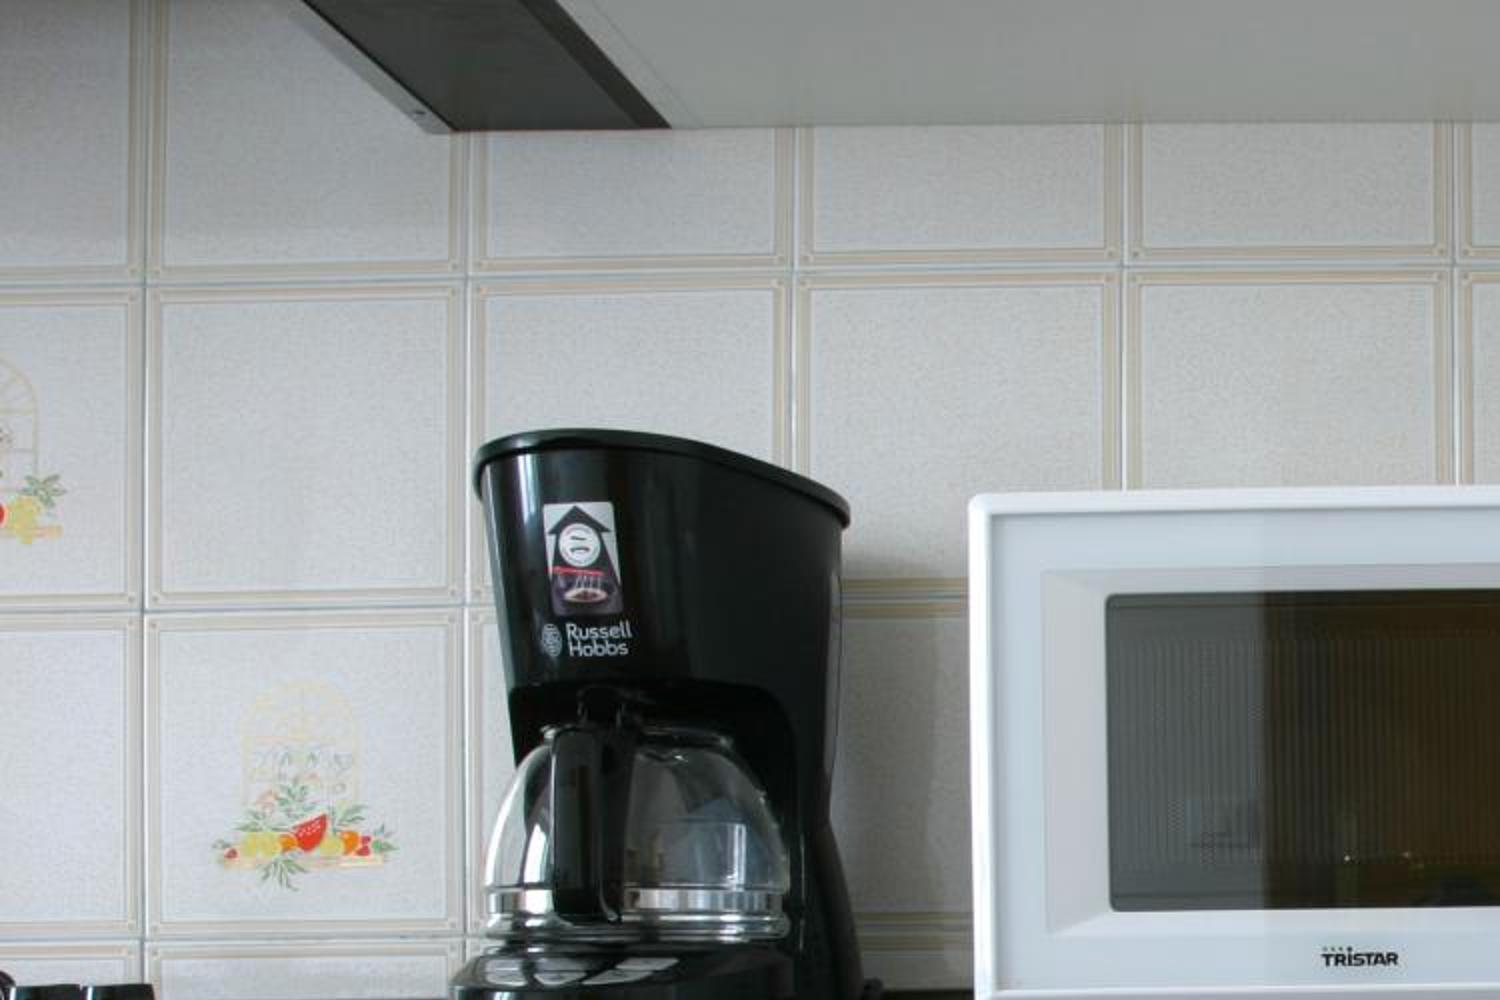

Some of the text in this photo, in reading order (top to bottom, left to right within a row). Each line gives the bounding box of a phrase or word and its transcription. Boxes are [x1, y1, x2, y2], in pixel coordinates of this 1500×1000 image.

[565, 621, 632, 640] Russell
[568, 640, 629, 657] Hobbs
[1321, 946, 1399, 967] TRISTAR
